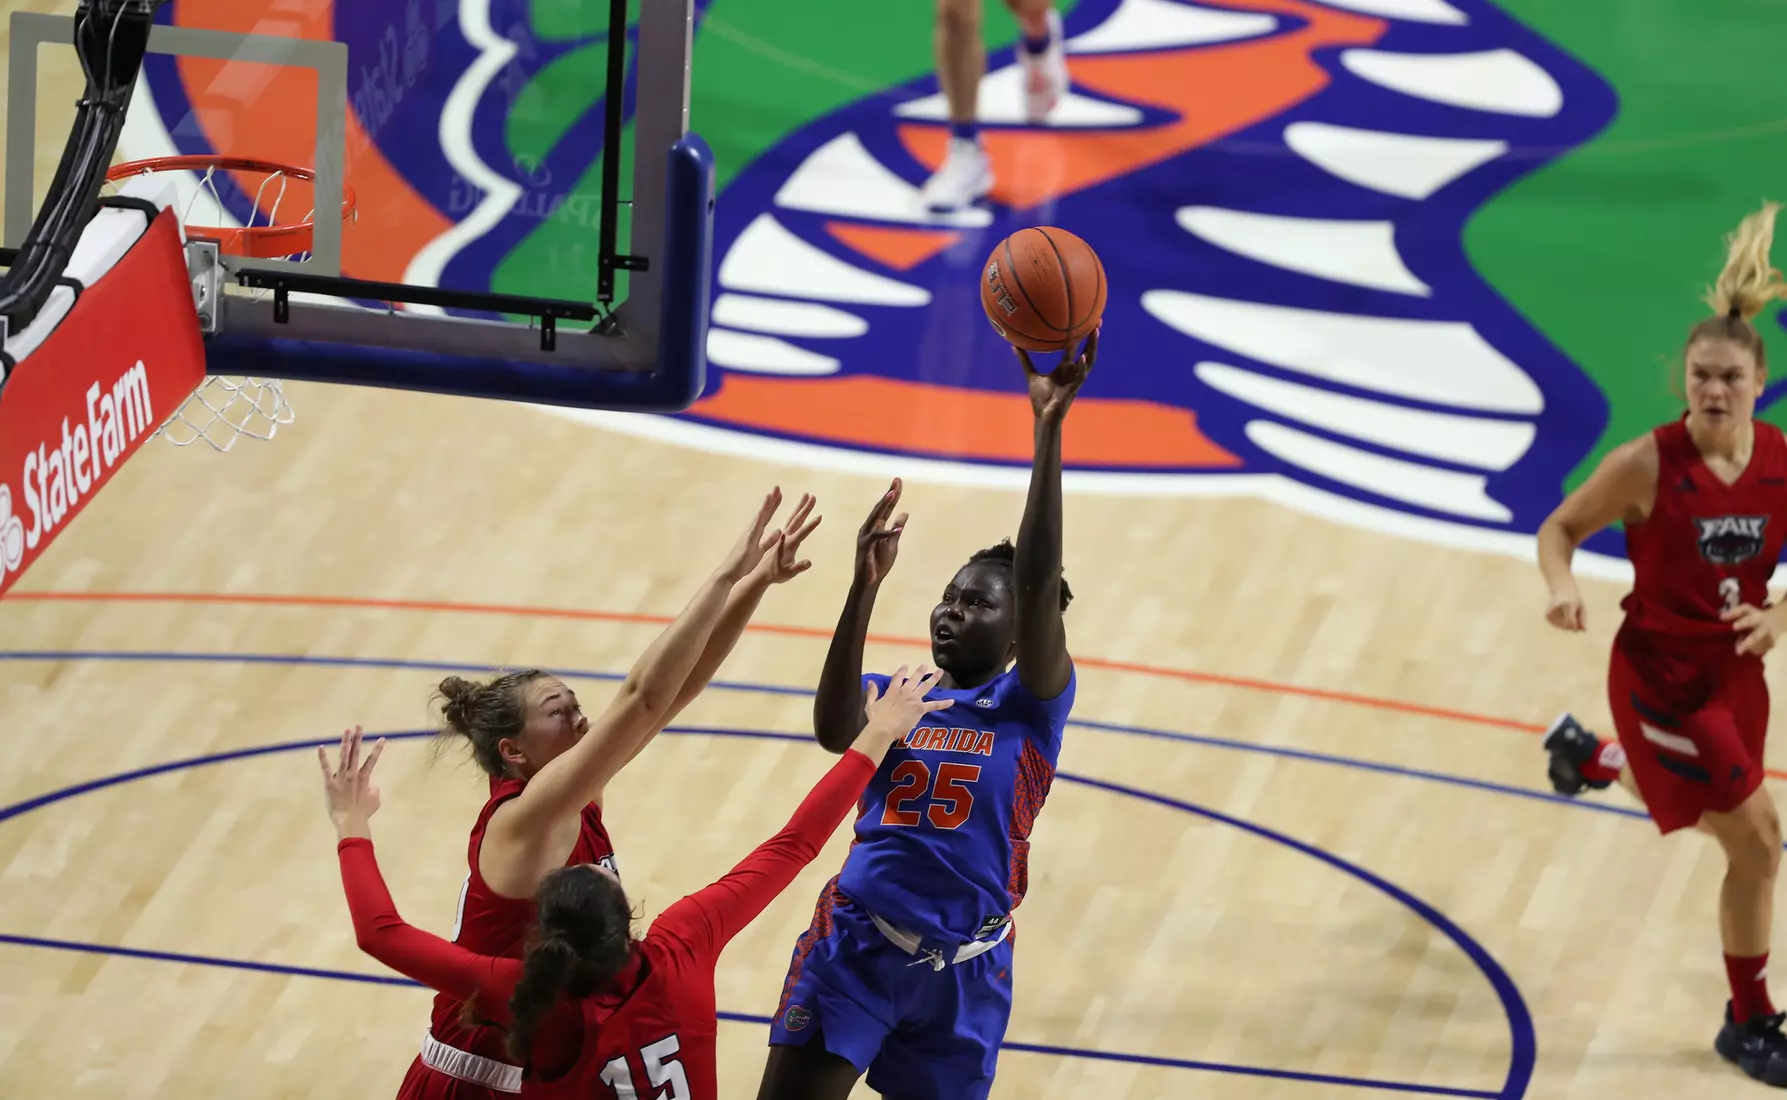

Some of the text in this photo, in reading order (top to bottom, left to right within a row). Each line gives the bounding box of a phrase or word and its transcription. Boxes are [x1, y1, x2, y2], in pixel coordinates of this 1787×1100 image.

[24, 359, 153, 549] StateFarm
[1699, 515, 1765, 543] FAU
[1718, 577, 1741, 615] 3
[894, 726, 996, 757] LORIDA
[880, 759, 982, 830] 25
[599, 1033, 693, 1100] 15
